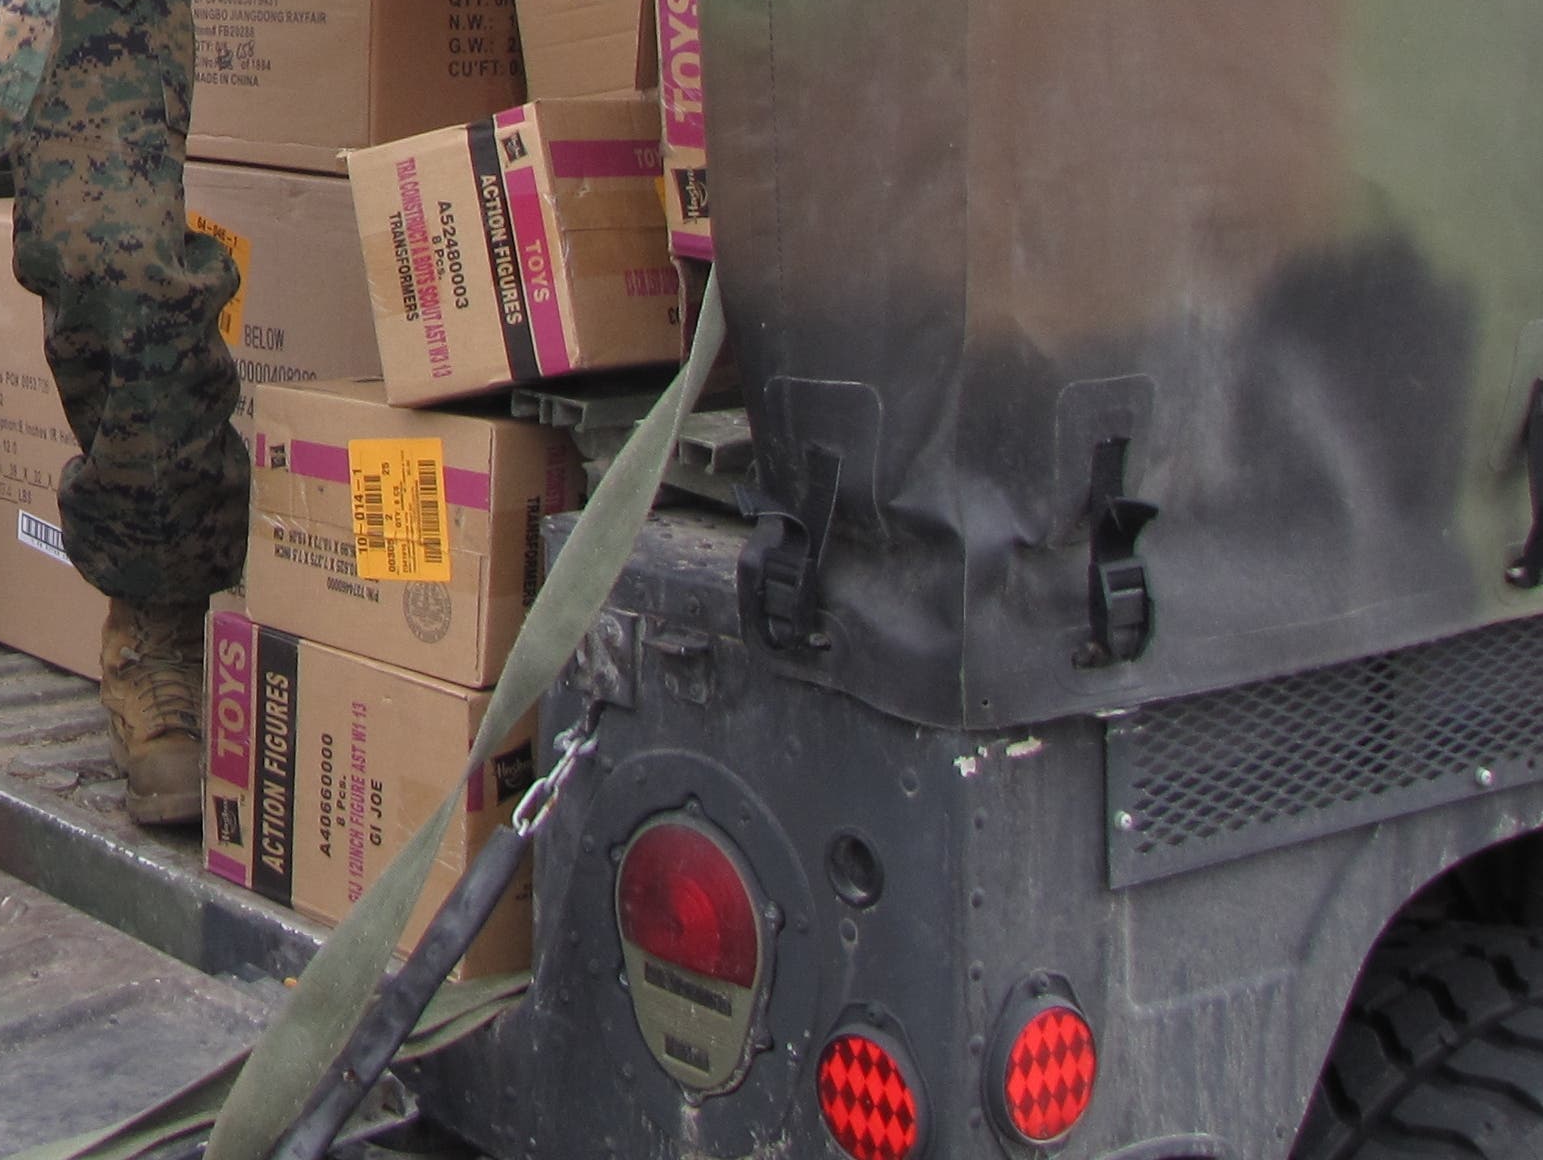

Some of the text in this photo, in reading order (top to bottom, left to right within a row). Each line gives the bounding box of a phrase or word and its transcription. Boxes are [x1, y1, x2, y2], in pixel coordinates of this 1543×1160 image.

[194, 8, 228, 21] NINGBO
[286, 11, 328, 25] RAYFAIR
[194, 72, 259, 87] MADE IN CHINA
[396, 156, 416, 181] TRA
[399, 181, 428, 244] CONSTRUCT
[389, 211, 419, 322] TRANSFORMERS
[413, 246, 429, 257] A
[437, 201, 469, 310] A52480003
[478, 173, 523, 326] ACTION FIGURES
[414, 257, 437, 285] BOTS
[525, 239, 551, 304] TOYS
[418, 286, 443, 321] SCOUT
[244, 324, 286, 351] BELOW
[425, 324, 448, 344] AST
[433, 365, 453, 379] 13
[18, 488, 33, 505] LBS
[522, 495, 541, 607] TRANSFORMERS
[217, 639, 247, 759] TOYS
[352, 701, 367, 719] 13
[260, 671, 290, 874] ACTION FIGURES
[351, 744, 366, 774] AST
[319, 733, 334, 858] A40660000
[349, 774, 365, 828] FIGURE
[369, 779, 383, 847] GI JOE
[349, 830, 365, 879] 12INCH
